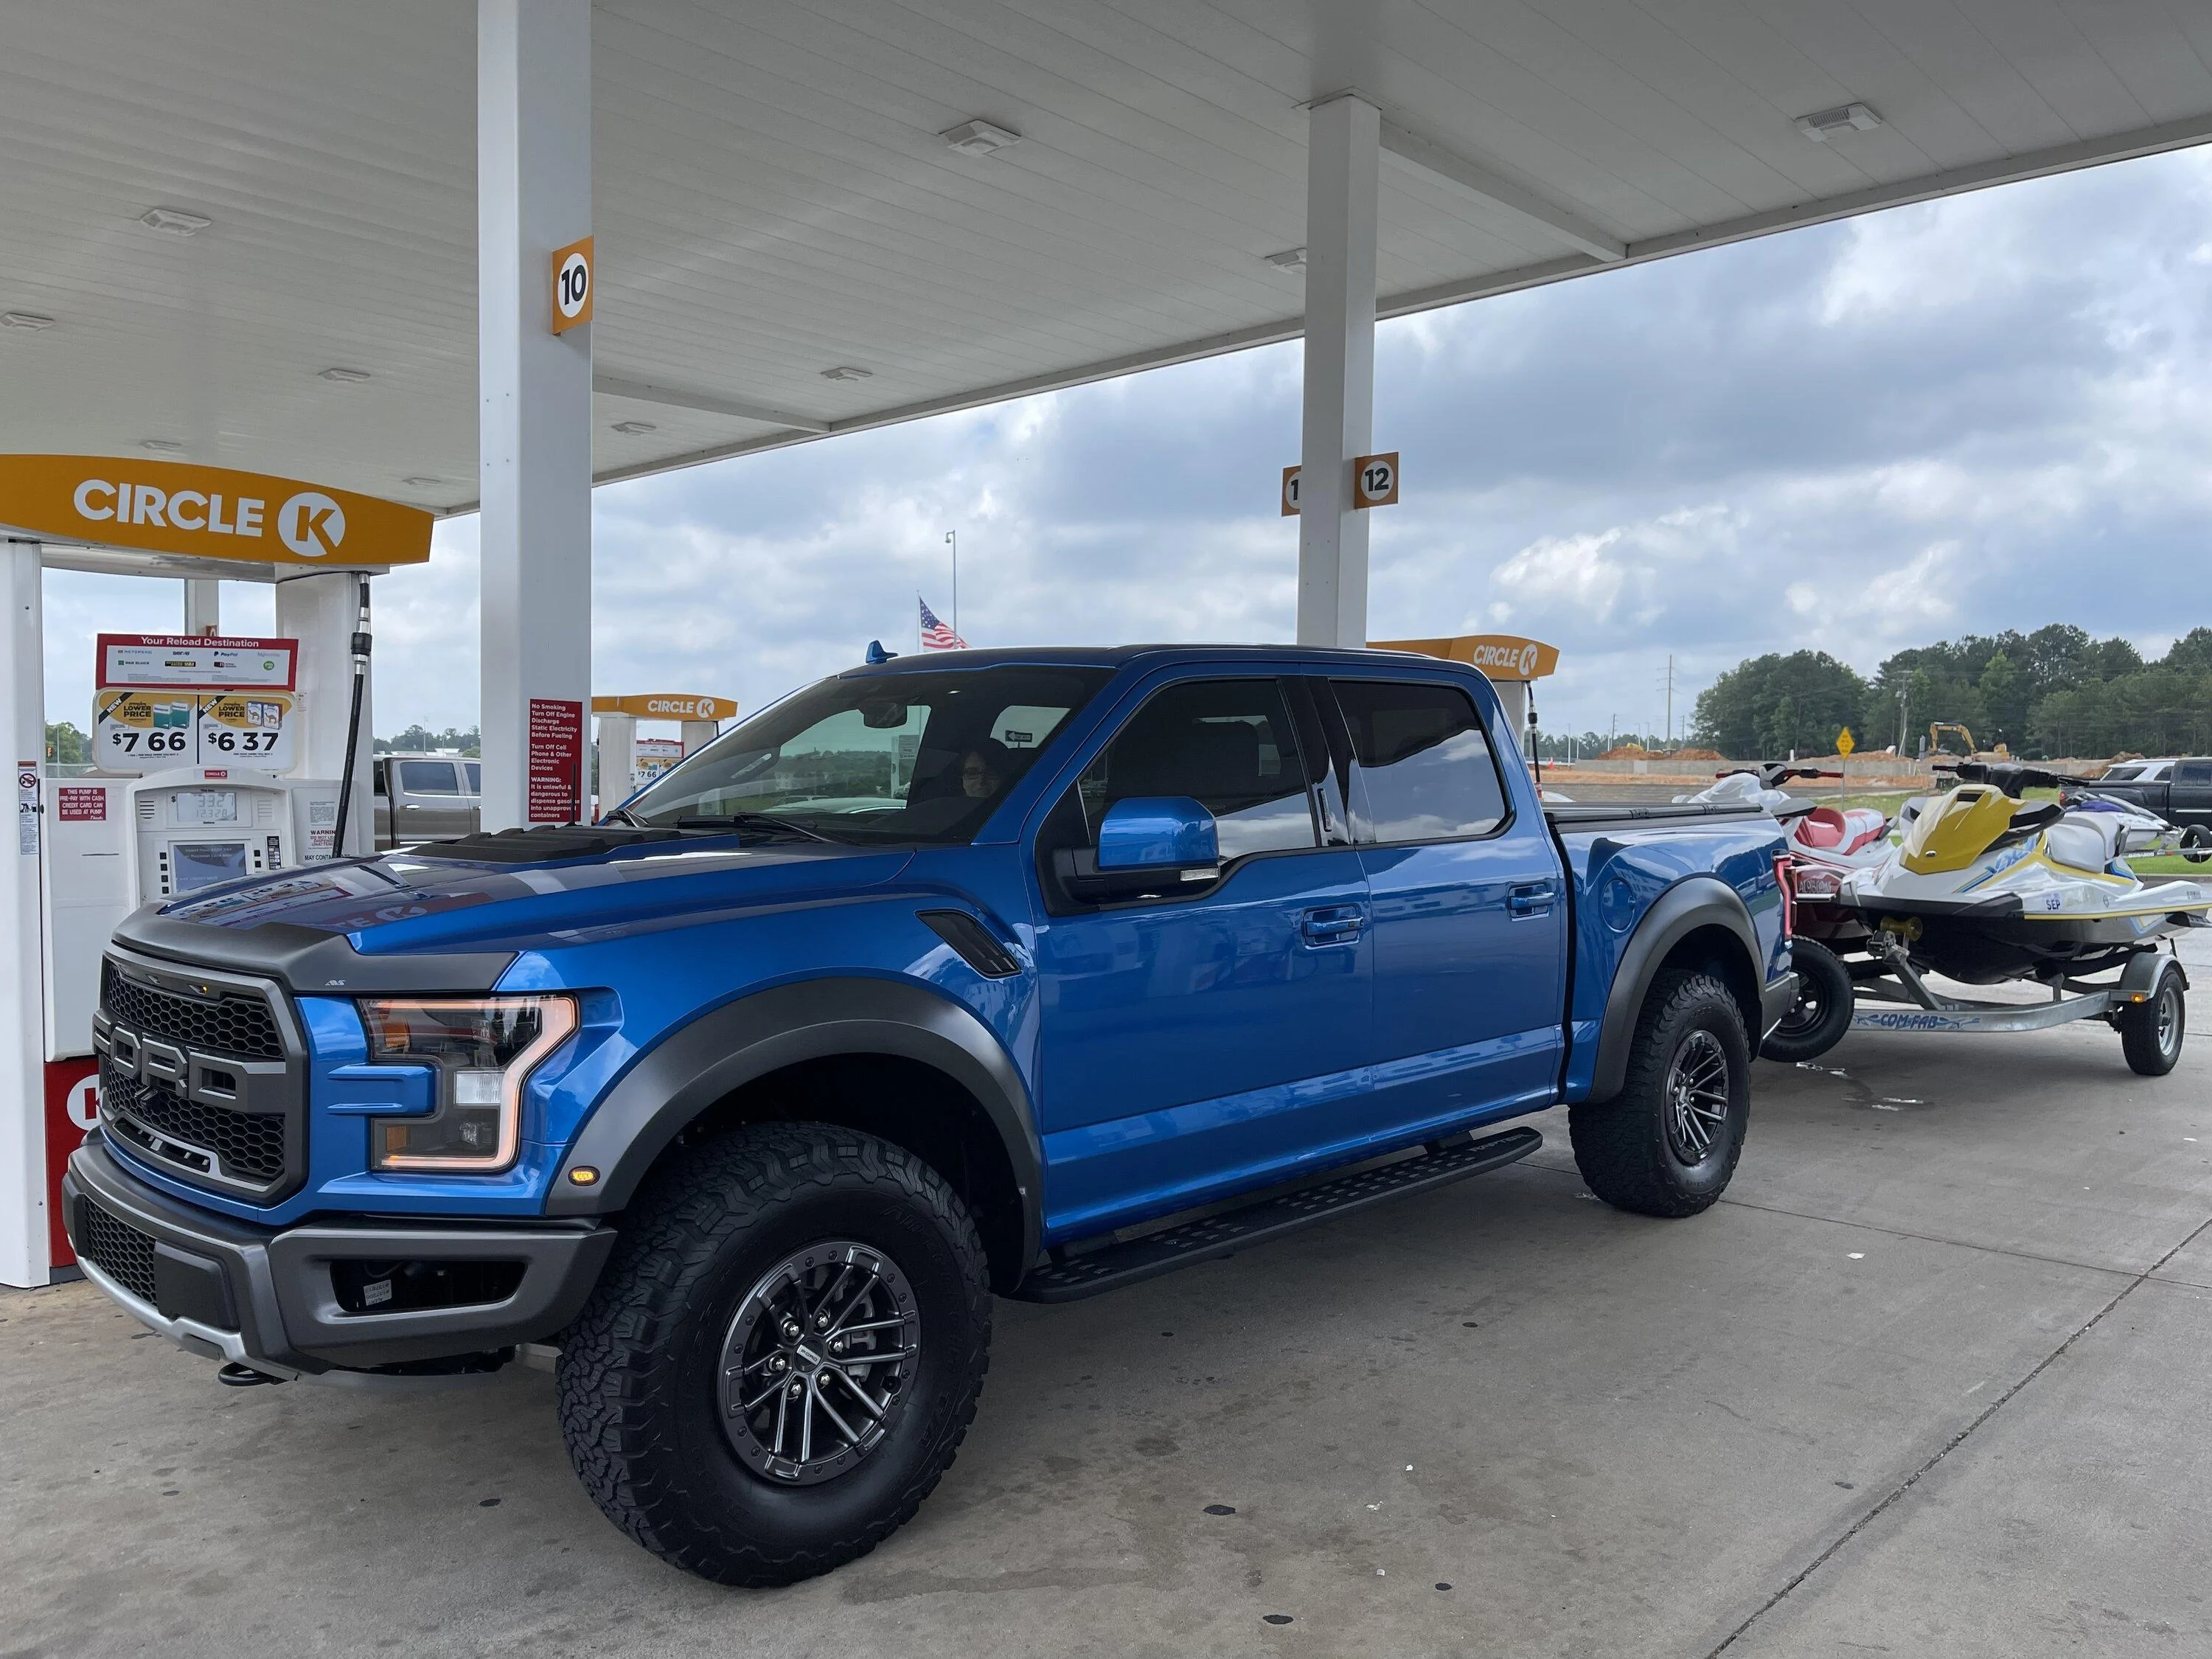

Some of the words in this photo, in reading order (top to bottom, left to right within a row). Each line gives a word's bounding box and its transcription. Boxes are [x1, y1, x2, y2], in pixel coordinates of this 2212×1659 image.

[561, 265, 586, 305] 10
[1291, 479, 1298, 501] 1
[1365, 467, 1389, 492] 12
[74, 479, 265, 538] CIRCLE
[141, 636, 164, 644] Your
[167, 637, 201, 646] Reload
[204, 639, 259, 647] Destination
[1473, 644, 1519, 667] CIRCLE
[106, 698, 122, 713] NEW
[202, 698, 218, 712] NEW
[648, 700, 695, 714] CIRCLE
[2046, 900, 2061, 910] SEP
[92, 1013, 251, 1112] FORD
